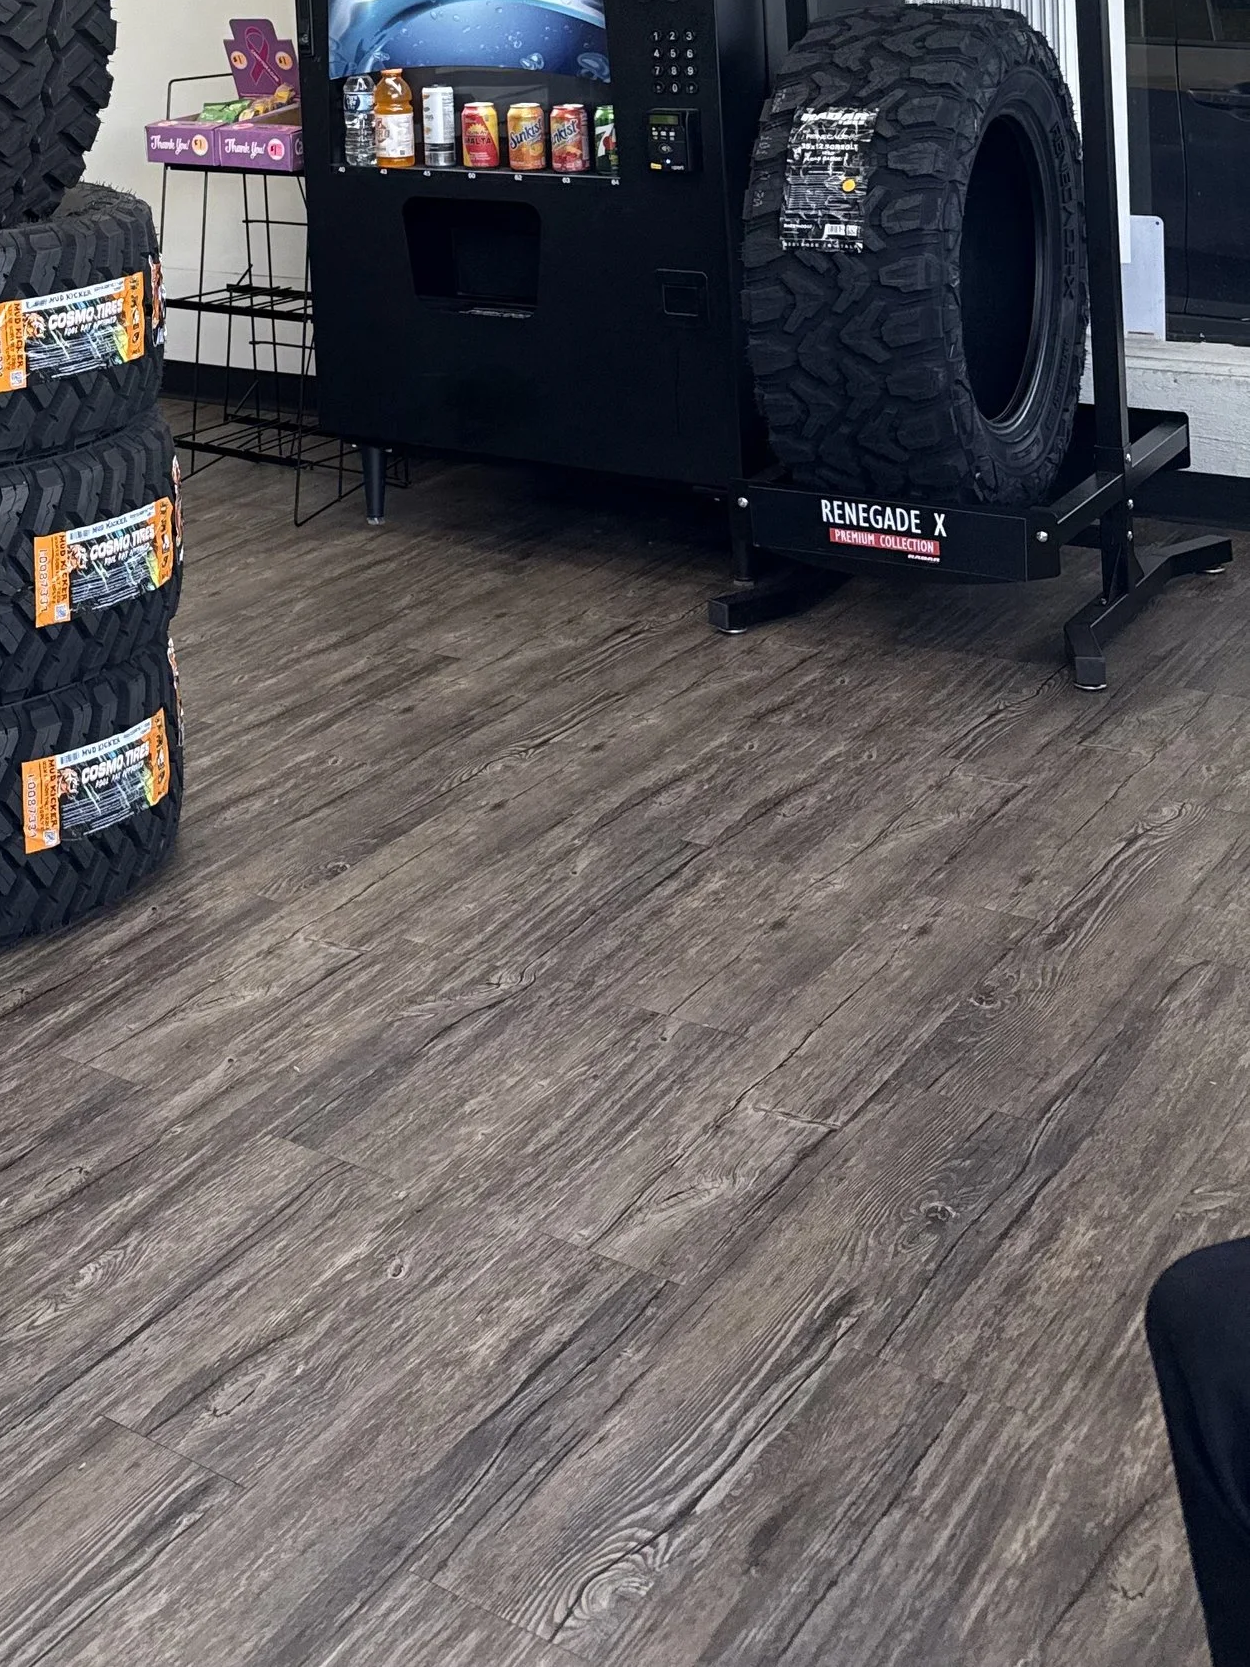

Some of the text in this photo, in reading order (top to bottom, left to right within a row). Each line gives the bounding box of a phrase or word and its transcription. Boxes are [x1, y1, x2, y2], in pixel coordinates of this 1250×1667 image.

[653, 32, 659, 40] 1
[669, 32, 675, 40] 2
[686, 32, 693, 41] 3
[654, 49, 660, 58] 4
[670, 49, 676, 58] 5
[686, 49, 693, 58] 6
[655, 67, 661, 75] 7
[671, 67, 677, 75] 8
[687, 67, 694, 75] 9
[672, 84, 678, 92] 0
[509, 118, 543, 149] Sunkist
[150, 134, 191, 155] Thank You!
[466, 136, 492, 145] MALTA
[224, 137, 266, 159] Thank You!
[49, 289, 92, 304] MUD KICKER
[13, 302, 21, 324] MUD
[49, 297, 125, 331] COSMO TIRES
[821, 499, 947, 537] RENEGADE X
[92, 524, 106, 534] MUD
[89, 533, 131, 561] COSMO
[132, 524, 155, 545] TIRES
[835, 529, 934, 553] PREMIUM COLLECTION
[58, 535, 68, 602] MUD KICKER
[82, 747, 97, 757] MUD
[81, 755, 125, 785] COSMO
[48, 759, 58, 829] MUD KICKER
